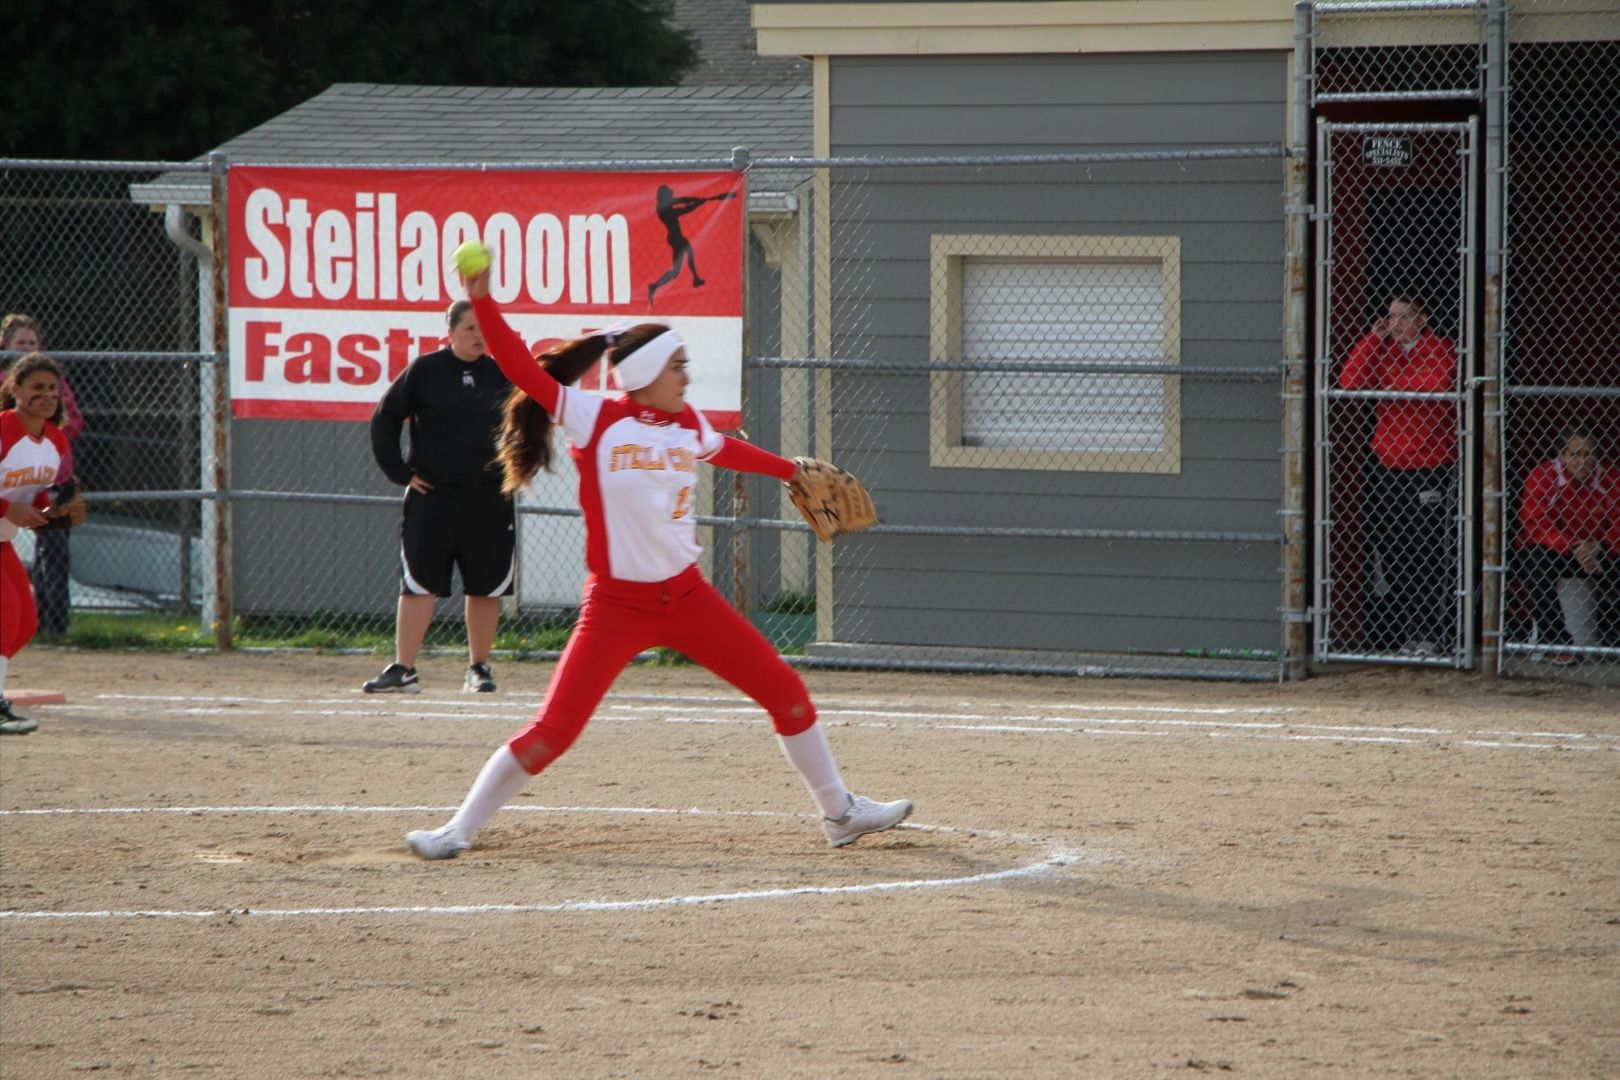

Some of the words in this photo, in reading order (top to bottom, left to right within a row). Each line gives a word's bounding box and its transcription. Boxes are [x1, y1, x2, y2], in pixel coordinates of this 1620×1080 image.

[1371, 138, 1402, 149] FENCE
[1365, 147, 1409, 160] SPECIALISTS
[244, 187, 631, 304] Steilacoom
